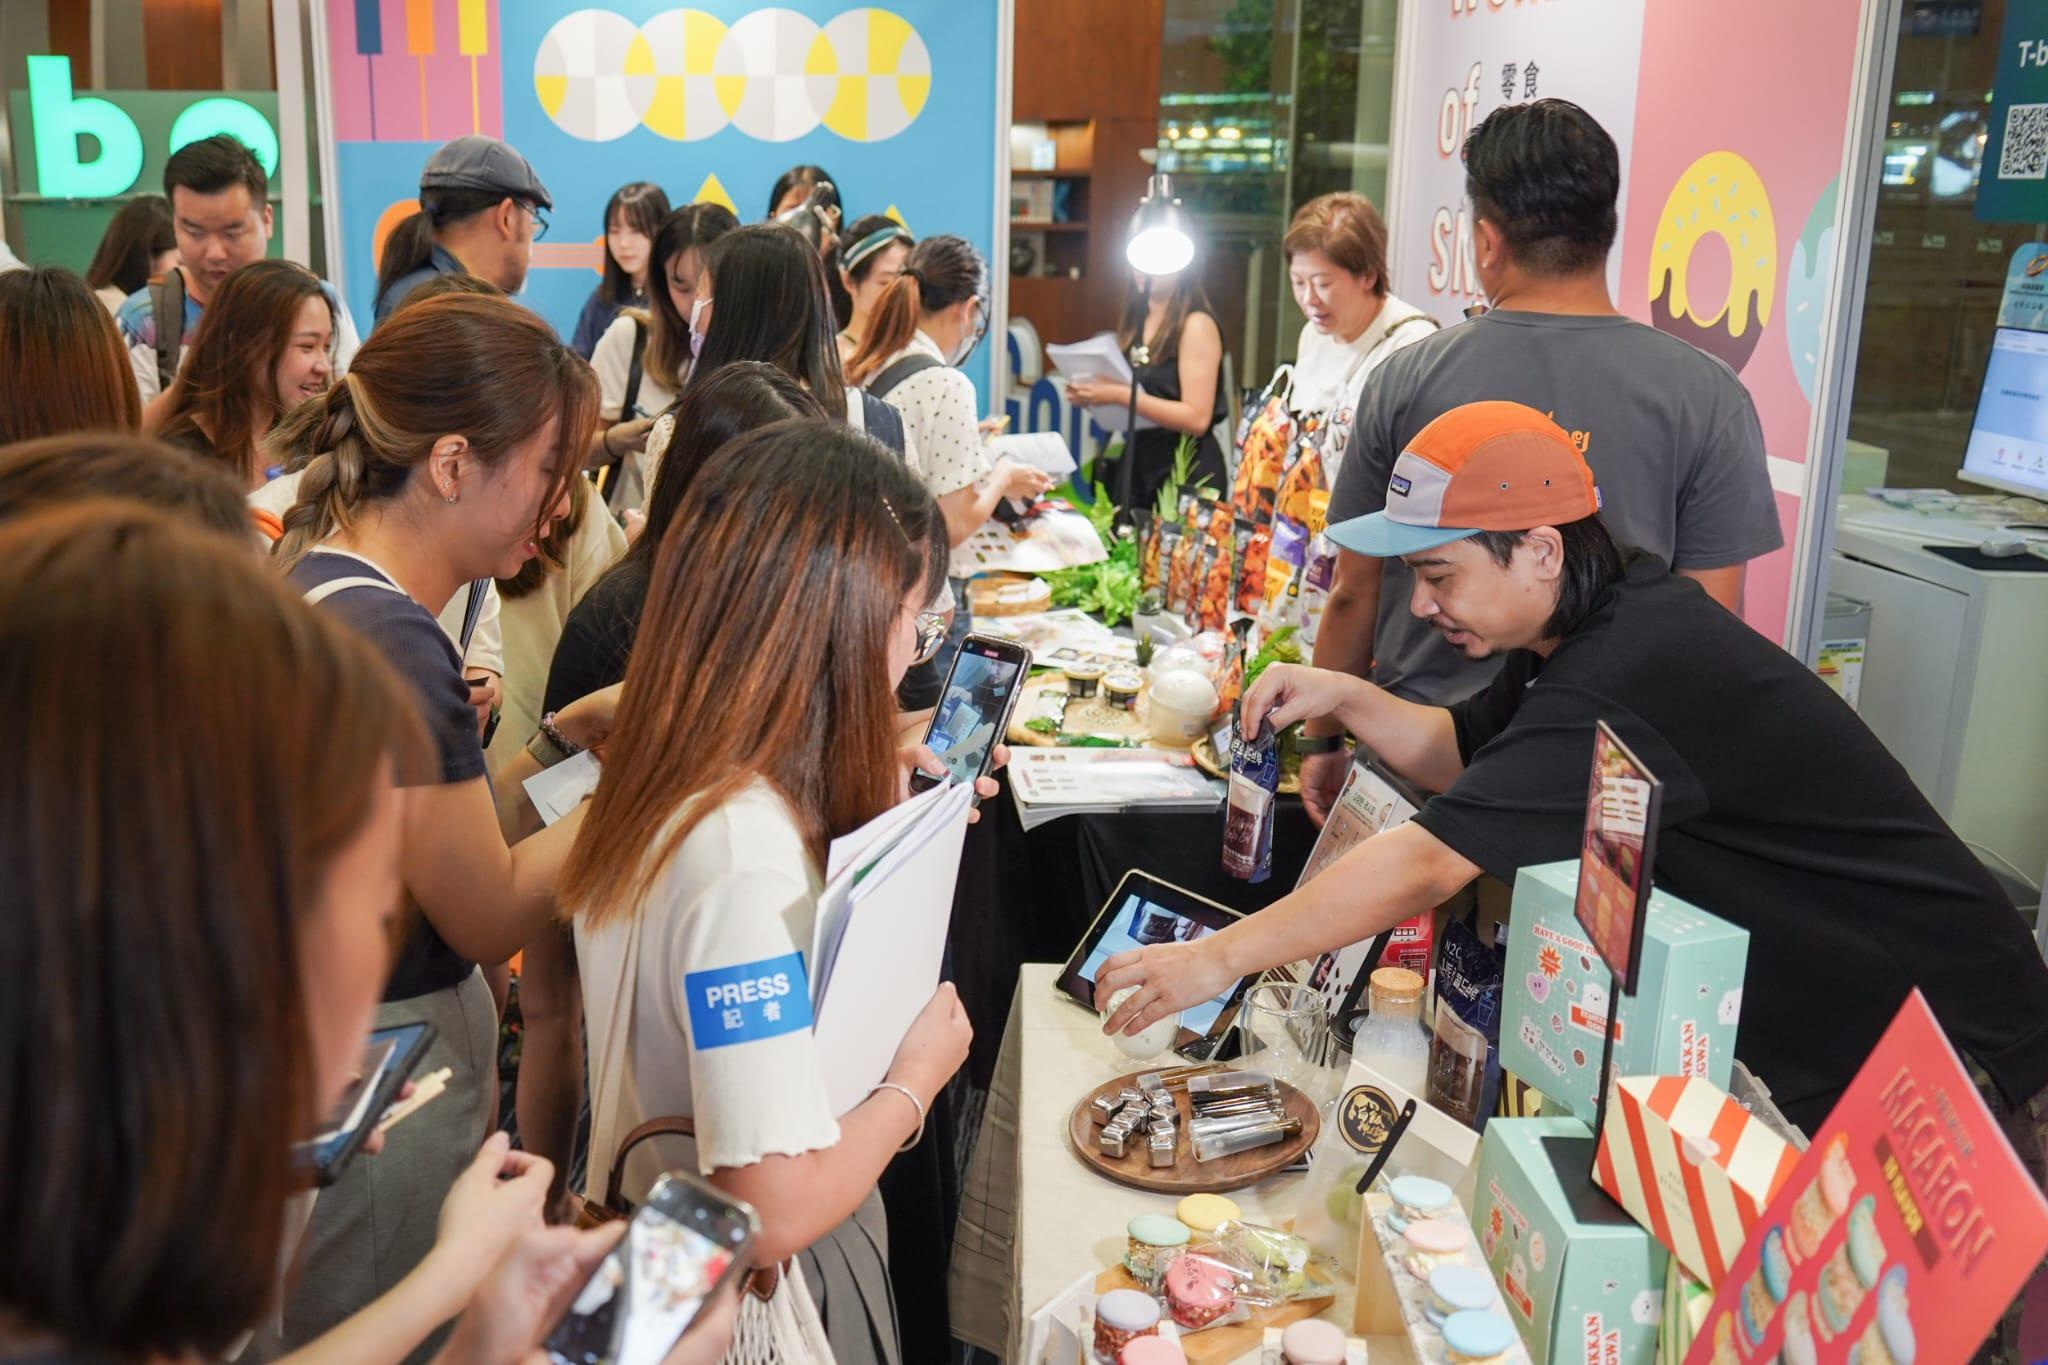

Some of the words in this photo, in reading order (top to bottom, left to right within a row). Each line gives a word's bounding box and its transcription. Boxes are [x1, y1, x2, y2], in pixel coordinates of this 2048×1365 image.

[1501, 61, 1539, 99] 零食
[1438, 61, 1482, 158] of
[1562, 937, 1584, 951] GOOD
[705, 972, 790, 1008] PRESS
[722, 1000, 782, 1030] 記者
[1587, 1315, 1600, 1365] KKAN
